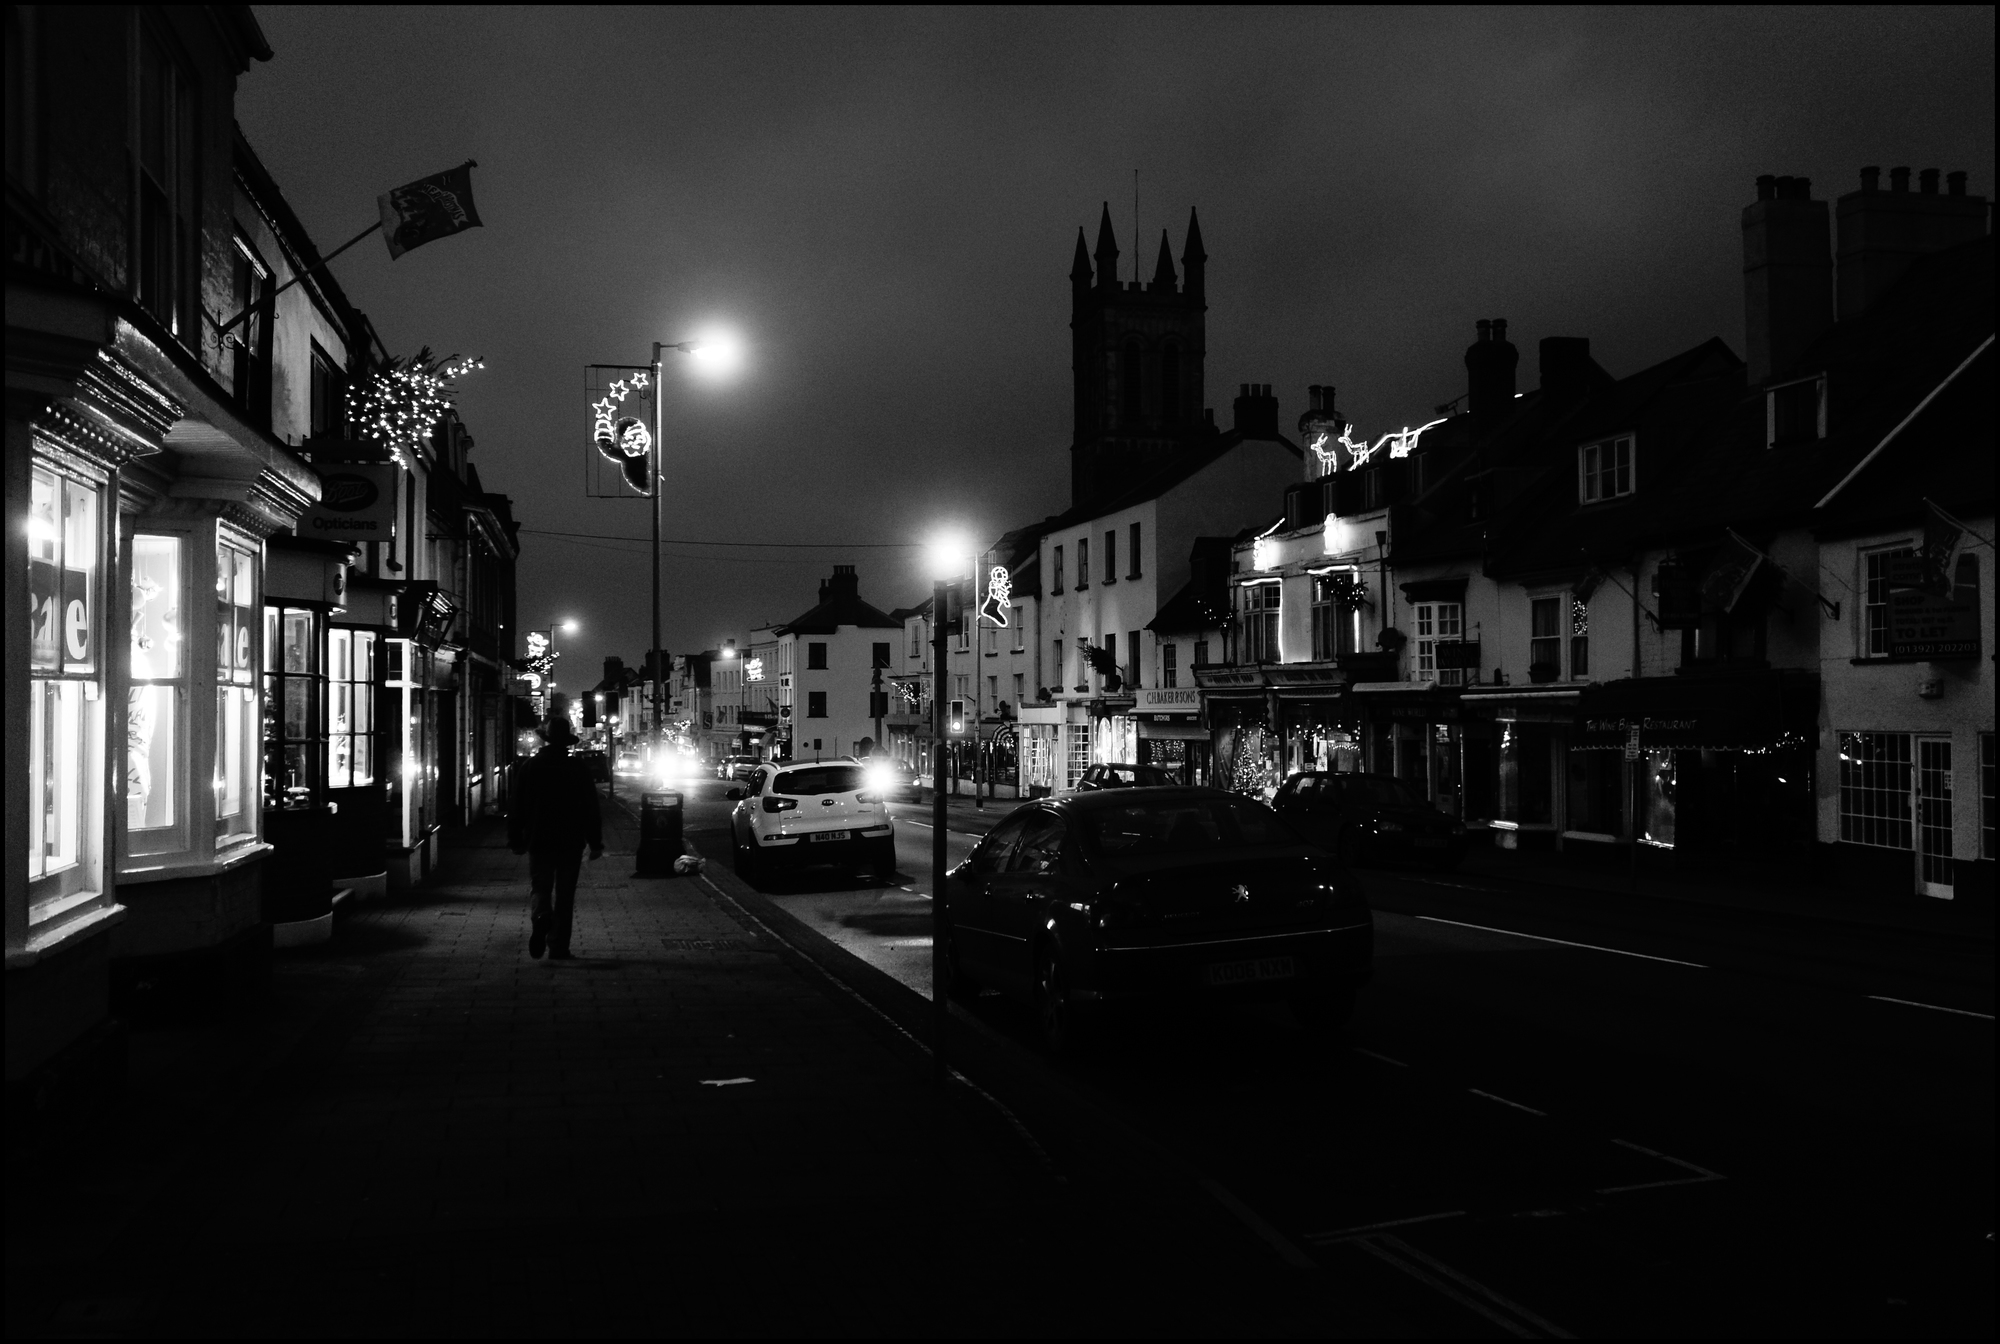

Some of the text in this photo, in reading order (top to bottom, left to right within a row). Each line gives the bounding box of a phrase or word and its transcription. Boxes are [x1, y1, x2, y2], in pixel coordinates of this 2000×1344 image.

[312, 516, 378, 531] Opticians
[1894, 596, 1925, 606] SHOP
[1895, 627, 1947, 639] TO LET
[1441, 647, 1472, 658] WINE
[1894, 642, 1977, 655] (01392) 202203
[1437, 657, 1479, 667] WORLD
[1586, 719, 1598, 732] THE
[1599, 718, 1617, 731] WINE
[1643, 717, 1698, 732] RESTAURANT
[1259, 957, 1292, 977] NXM
